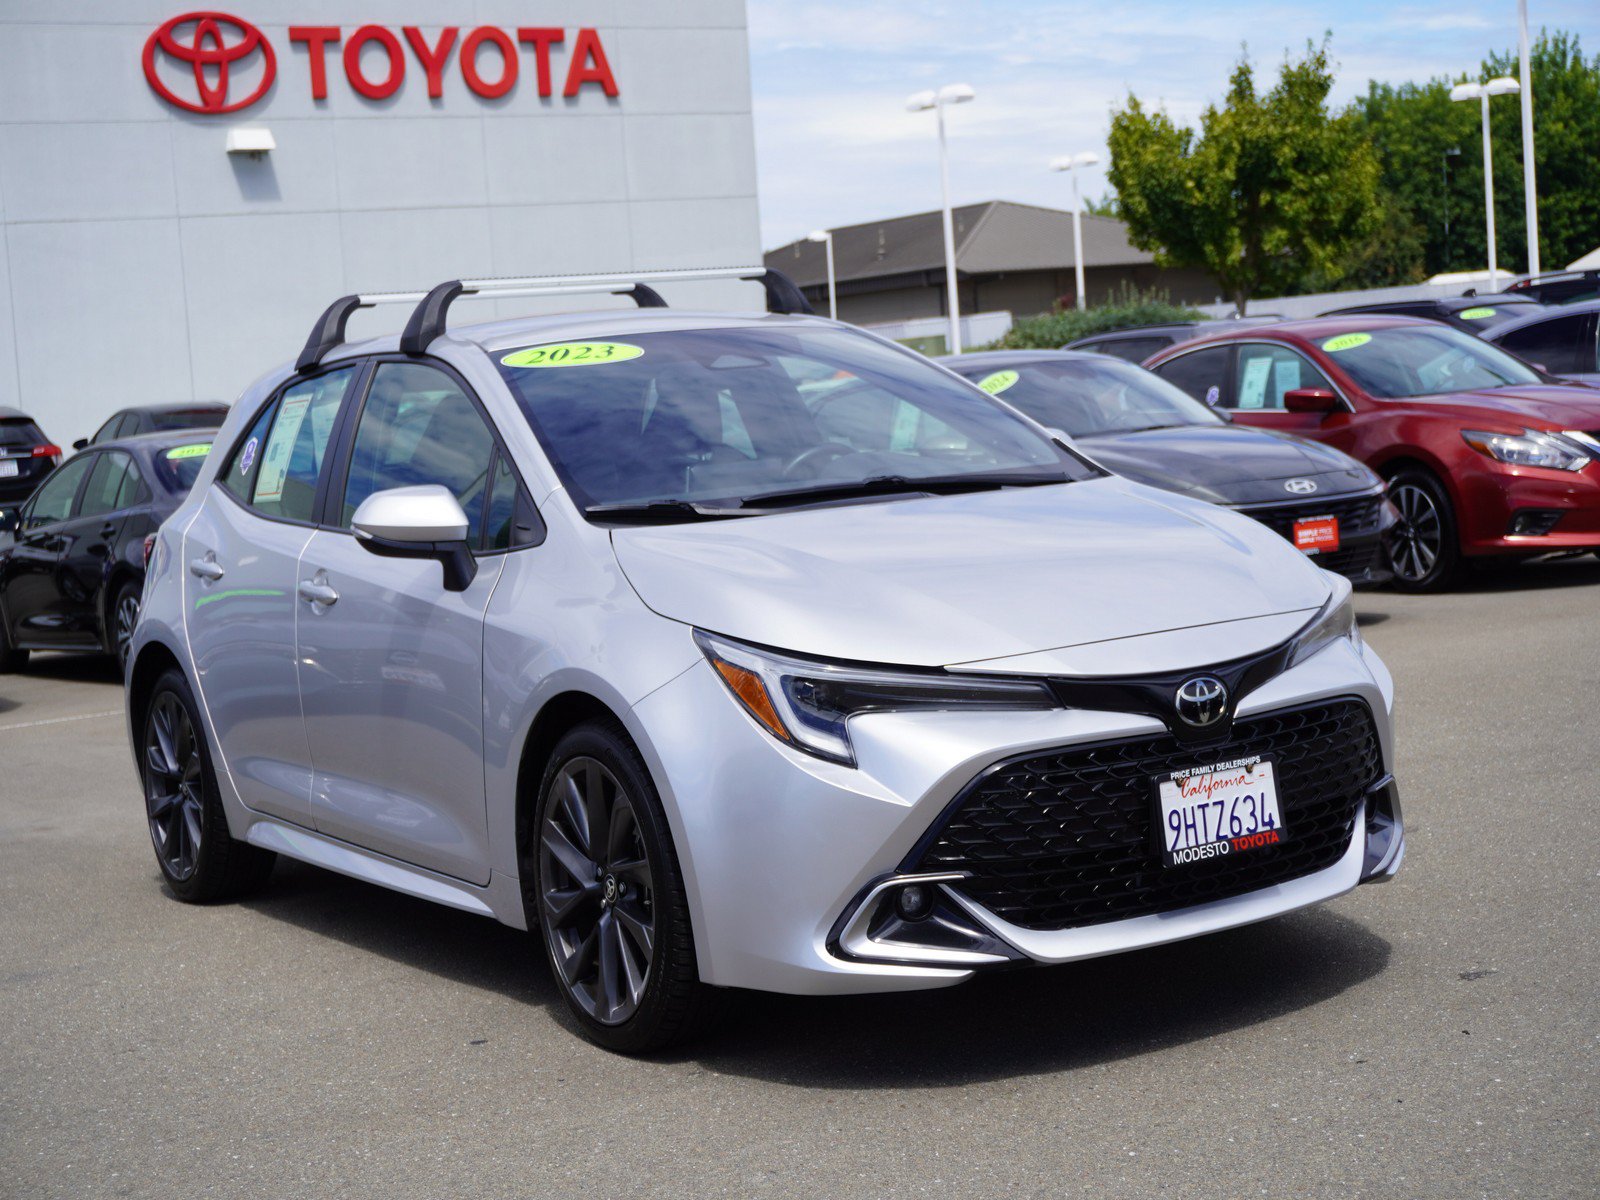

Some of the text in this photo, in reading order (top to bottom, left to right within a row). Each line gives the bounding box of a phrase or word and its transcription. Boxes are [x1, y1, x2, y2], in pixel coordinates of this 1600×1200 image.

[288, 24, 620, 100] TOYOTA
[526, 345, 615, 364] 2023
[1170, 755, 1260, 780] PRICE FAMILY DEALERSHIPS
[1181, 770, 1254, 799] California
[1168, 792, 1275, 851] 9HTZ634
[1173, 831, 1280, 865] MODESTO TOYOTA
